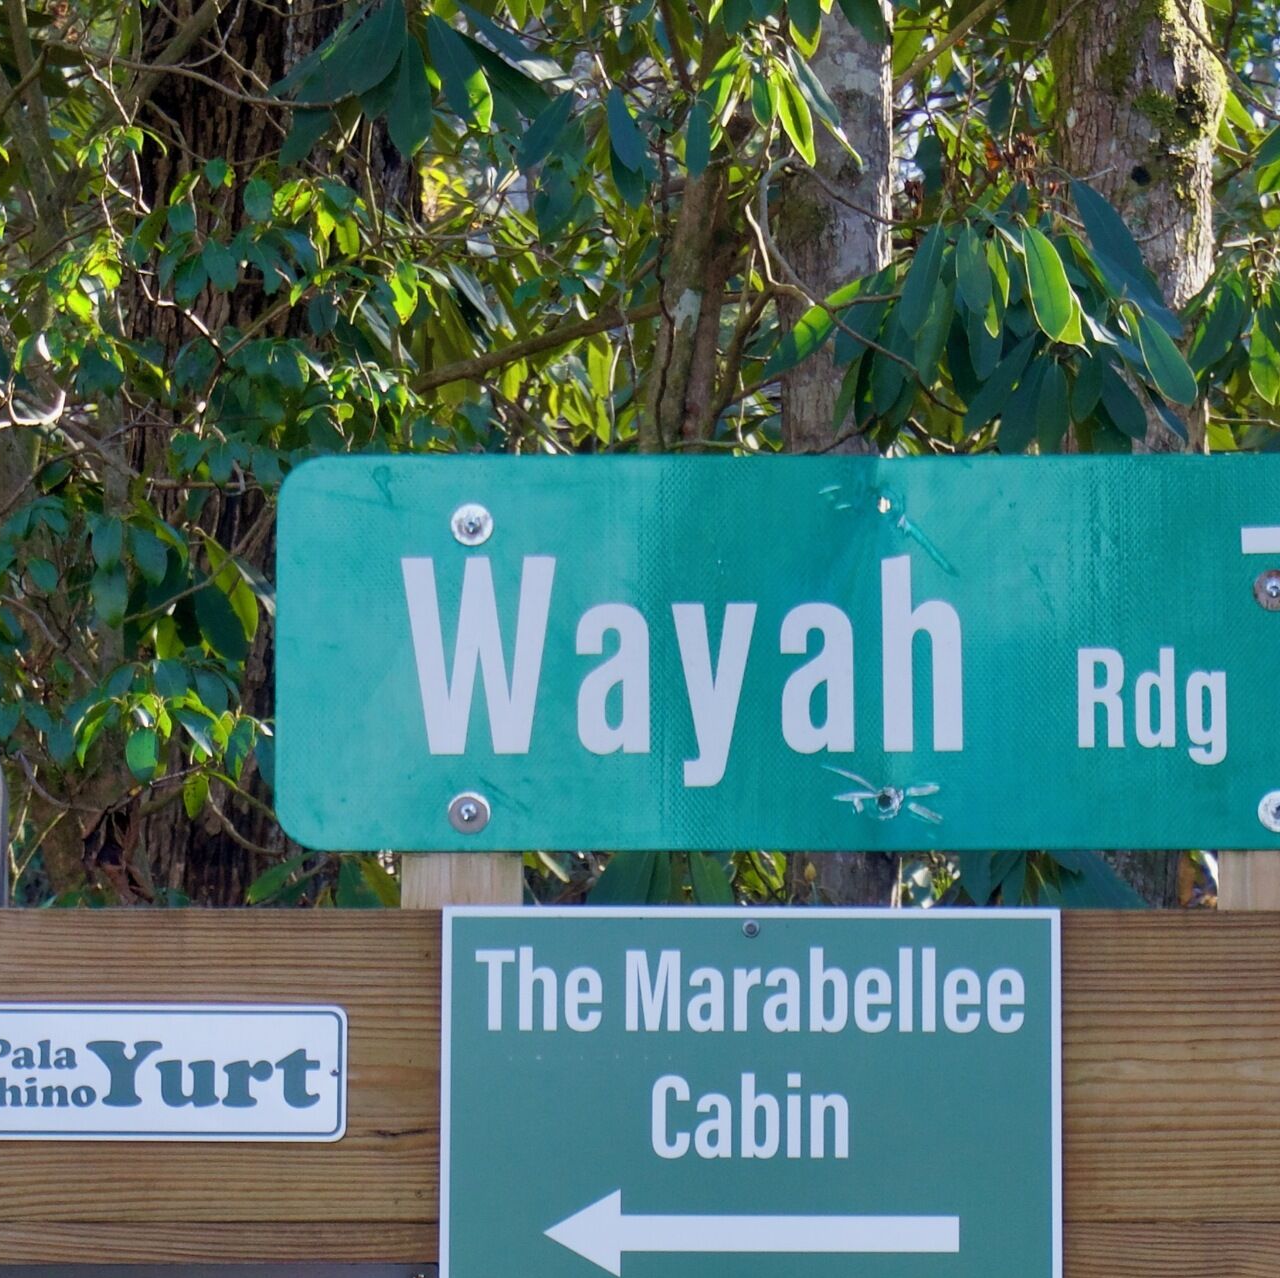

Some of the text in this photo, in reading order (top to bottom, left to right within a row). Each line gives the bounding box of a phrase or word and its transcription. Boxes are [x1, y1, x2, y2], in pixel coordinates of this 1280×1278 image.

[401, 555, 964, 787] Wayah
[1076, 646, 1228, 765] Rdg
[475, 946, 1026, 1034] The Marabellee
[86, 1040, 321, 1109] Yurt
[651, 1072, 850, 1160] Cabin
